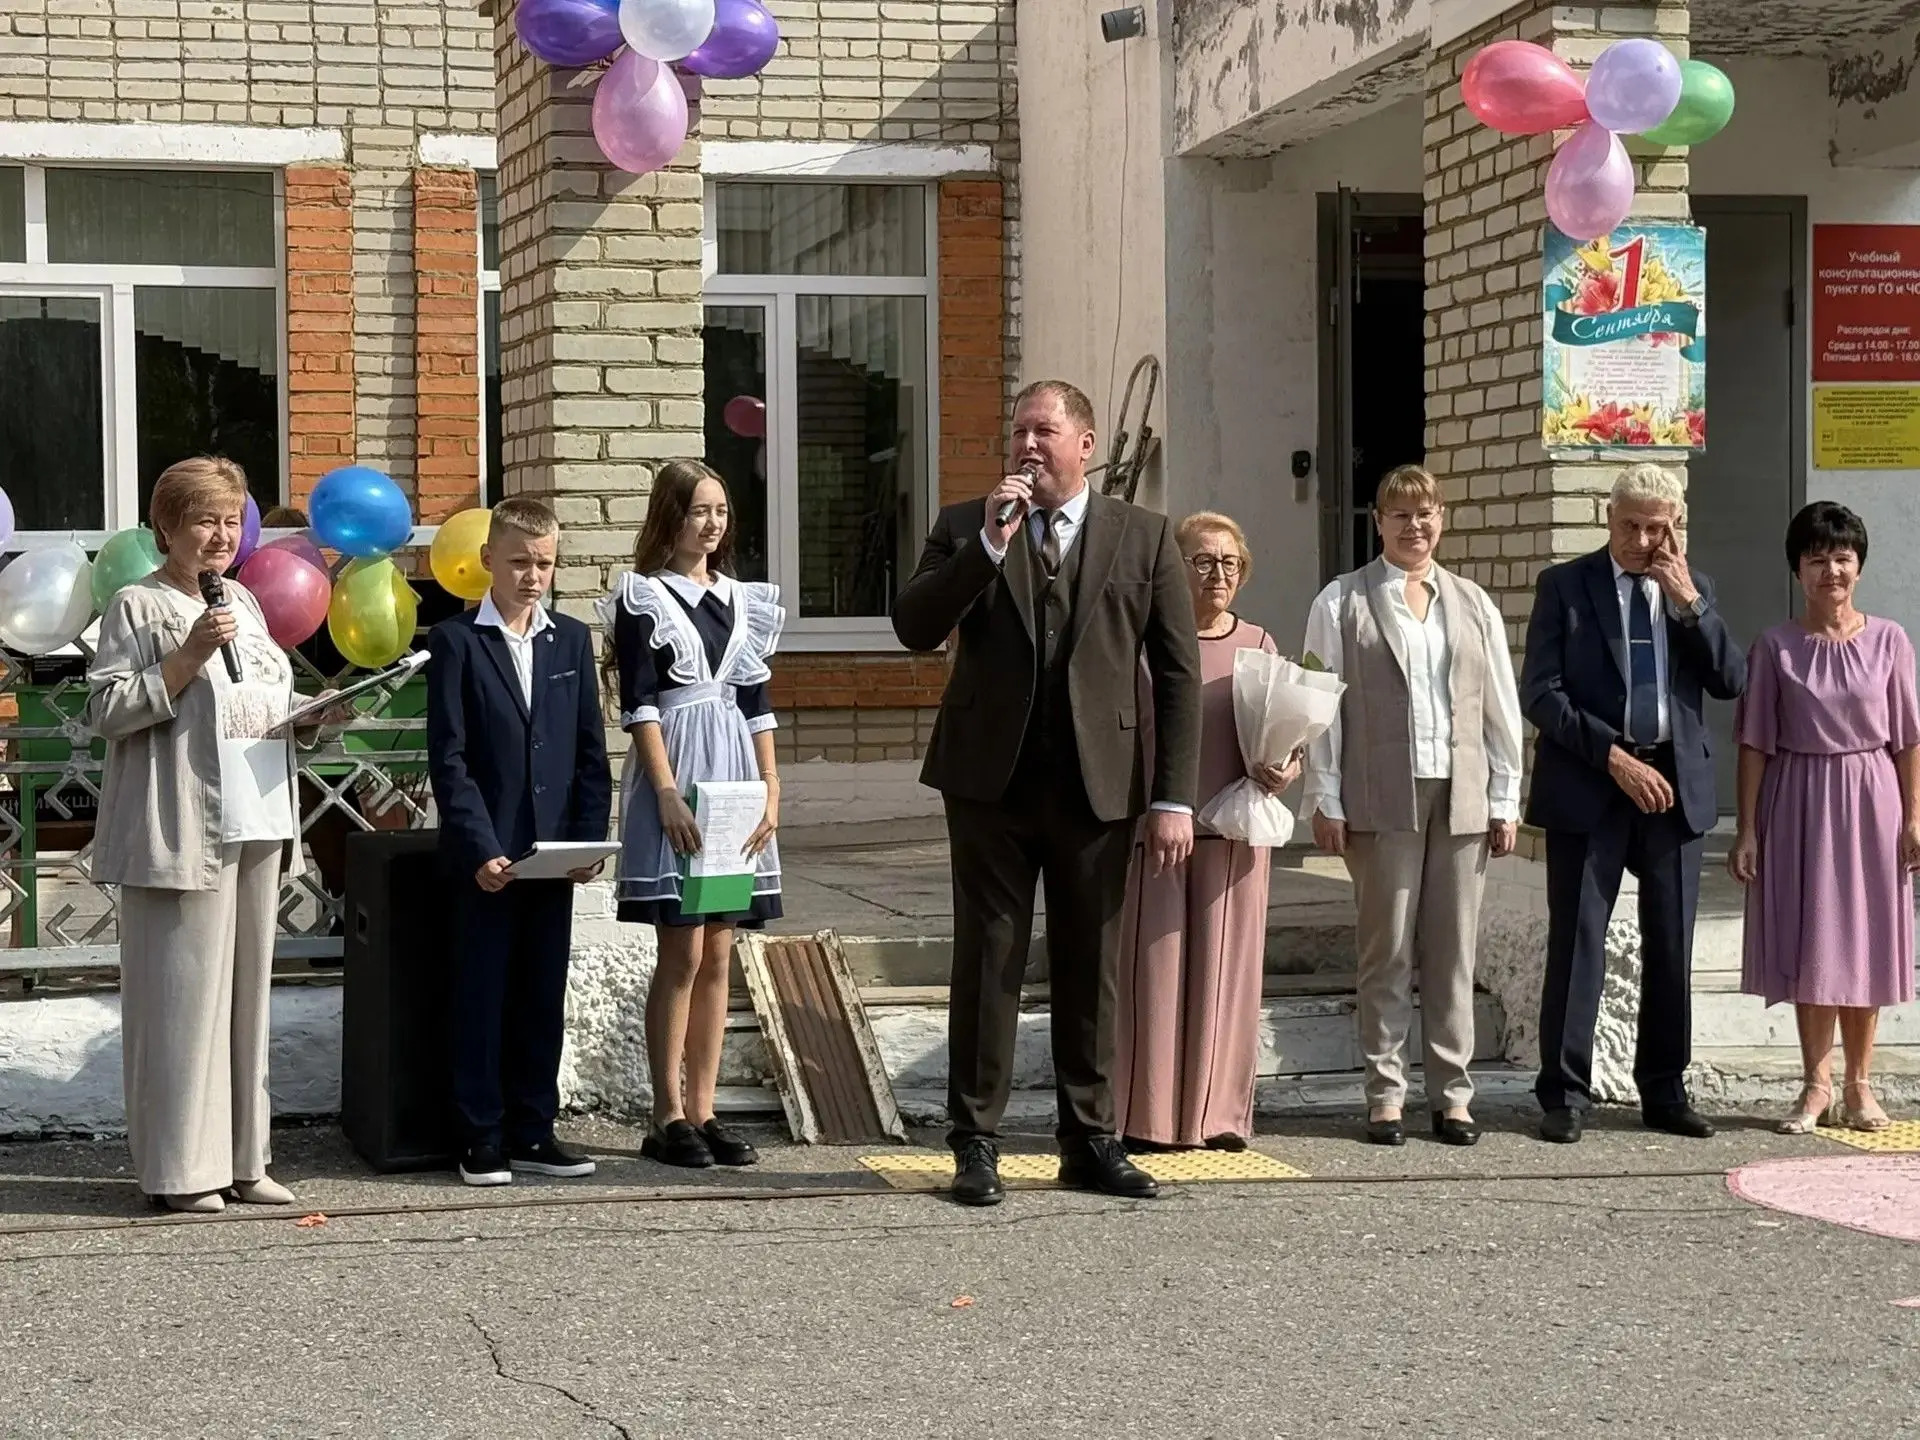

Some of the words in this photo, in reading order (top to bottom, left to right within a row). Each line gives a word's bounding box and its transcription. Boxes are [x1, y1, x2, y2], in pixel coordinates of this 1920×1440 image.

[1848, 250, 1901, 263] Учебный
[1607, 234, 1645, 309] 1
[1825, 284, 1858, 296] пункт
[1861, 284, 1876, 294] по
[1878, 283, 1894, 295] ГО
[1896, 285, 1904, 295] и
[1571, 307, 1674, 338] Сентября
[1828, 340, 1855, 351] Среда
[1857, 342, 1863, 350] с
[1865, 341, 1888, 350] 14.00
[1823, 352, 1860, 362] Пятница
